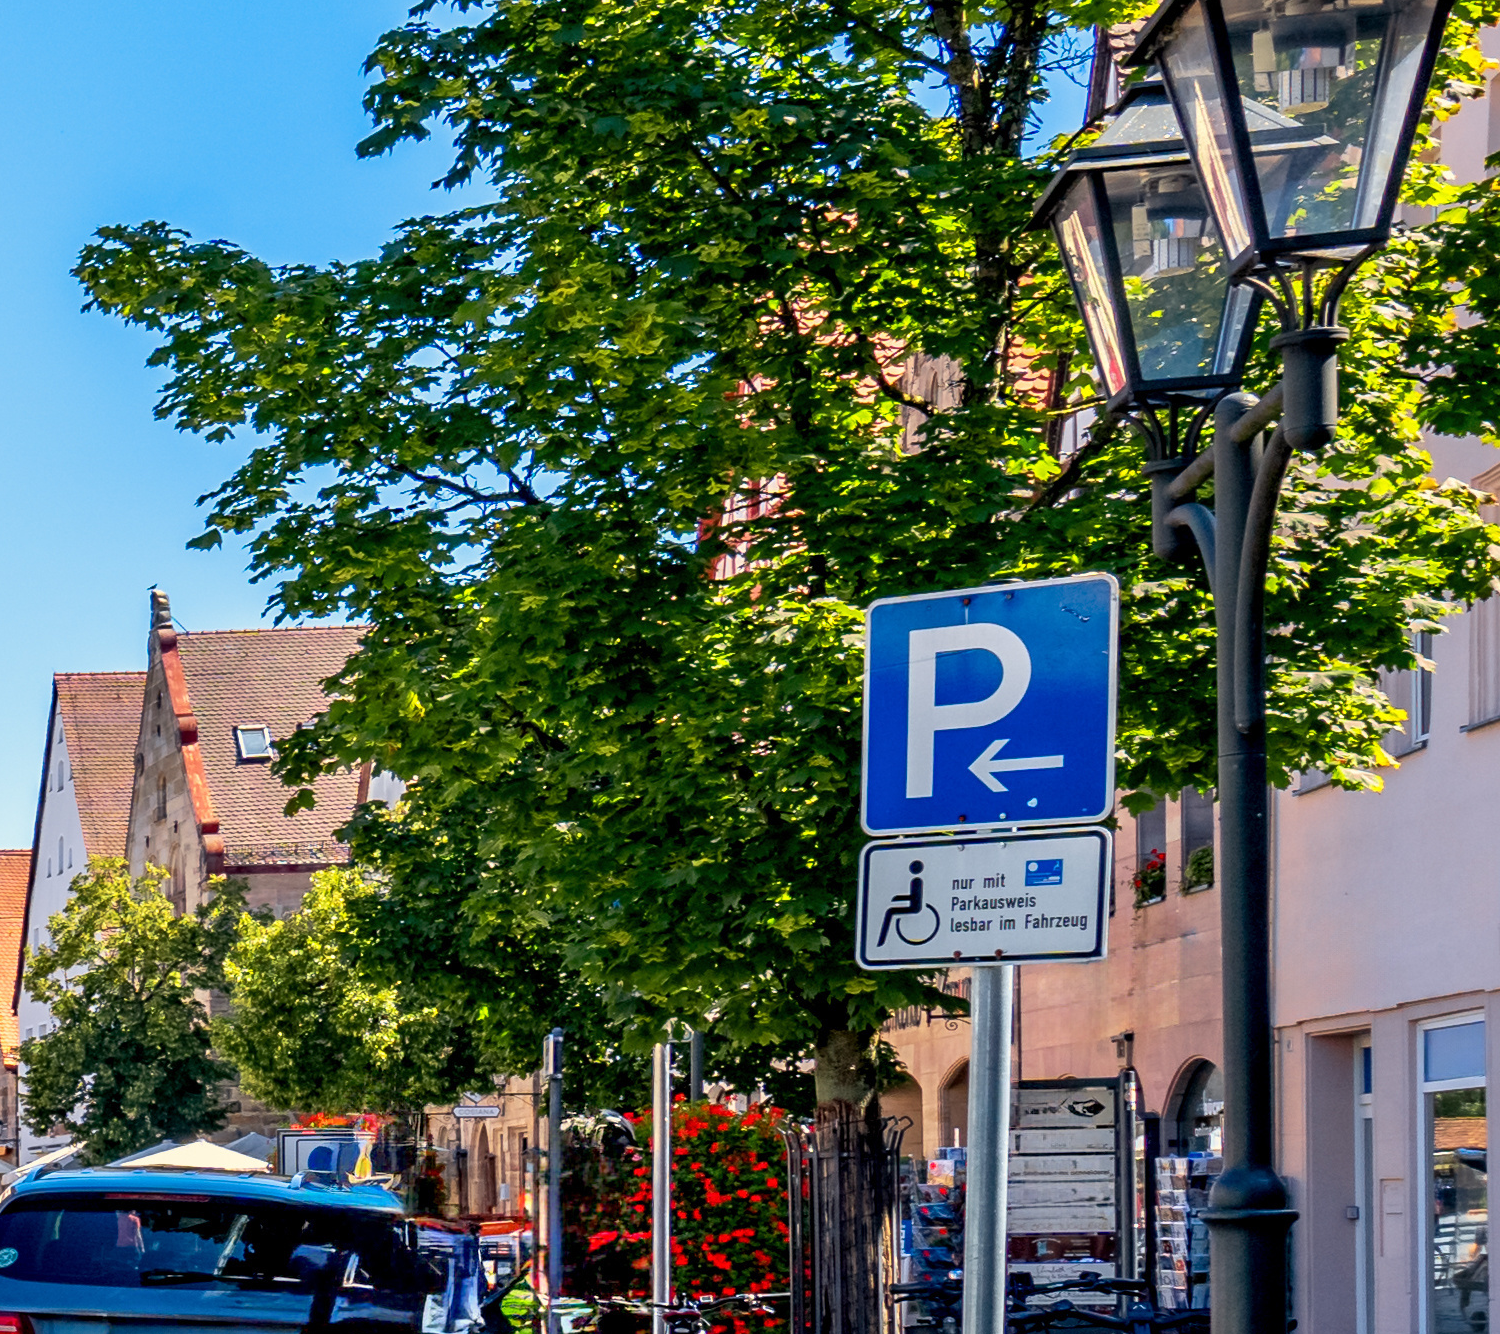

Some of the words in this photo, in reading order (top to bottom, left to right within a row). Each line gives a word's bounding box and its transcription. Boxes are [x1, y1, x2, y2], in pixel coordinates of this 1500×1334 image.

[906, 622, 1032, 799] P
[952, 877, 975, 891] nur
[983, 873, 1006, 889] mit
[951, 893, 1037, 911] Parkausweis
[950, 917, 993, 932] lesbar
[999, 915, 1016, 930] im
[1024, 913, 1088, 931] Fahrzeug
